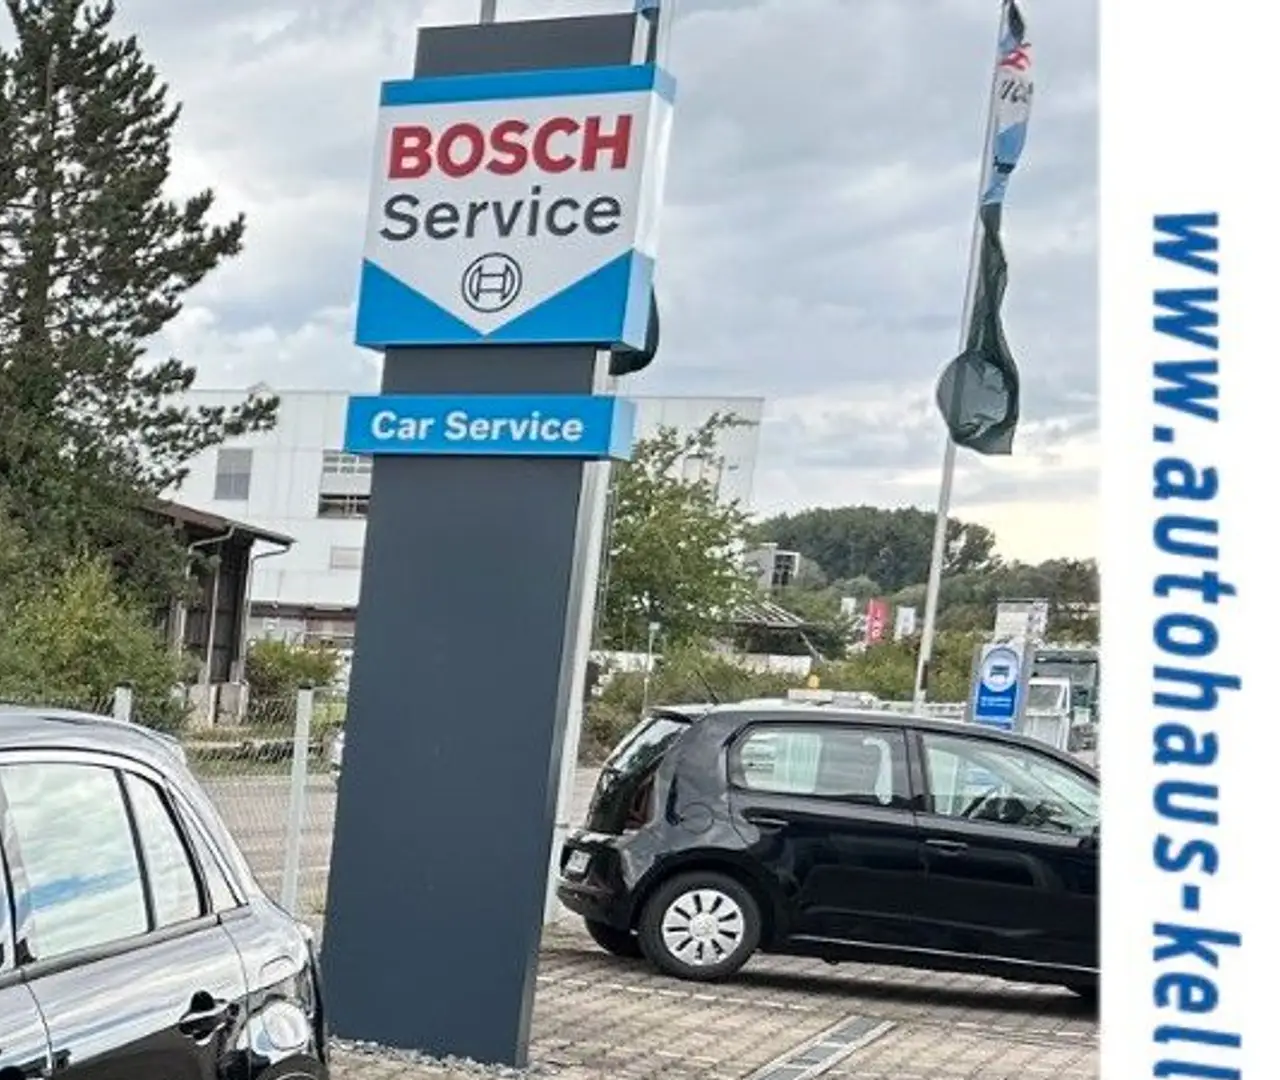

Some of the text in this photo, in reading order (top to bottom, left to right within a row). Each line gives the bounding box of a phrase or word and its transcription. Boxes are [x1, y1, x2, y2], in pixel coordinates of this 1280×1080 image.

[388, 114, 633, 179] BOSCH
[379, 186, 621, 242] Service
[371, 410, 585, 442] Car Service
